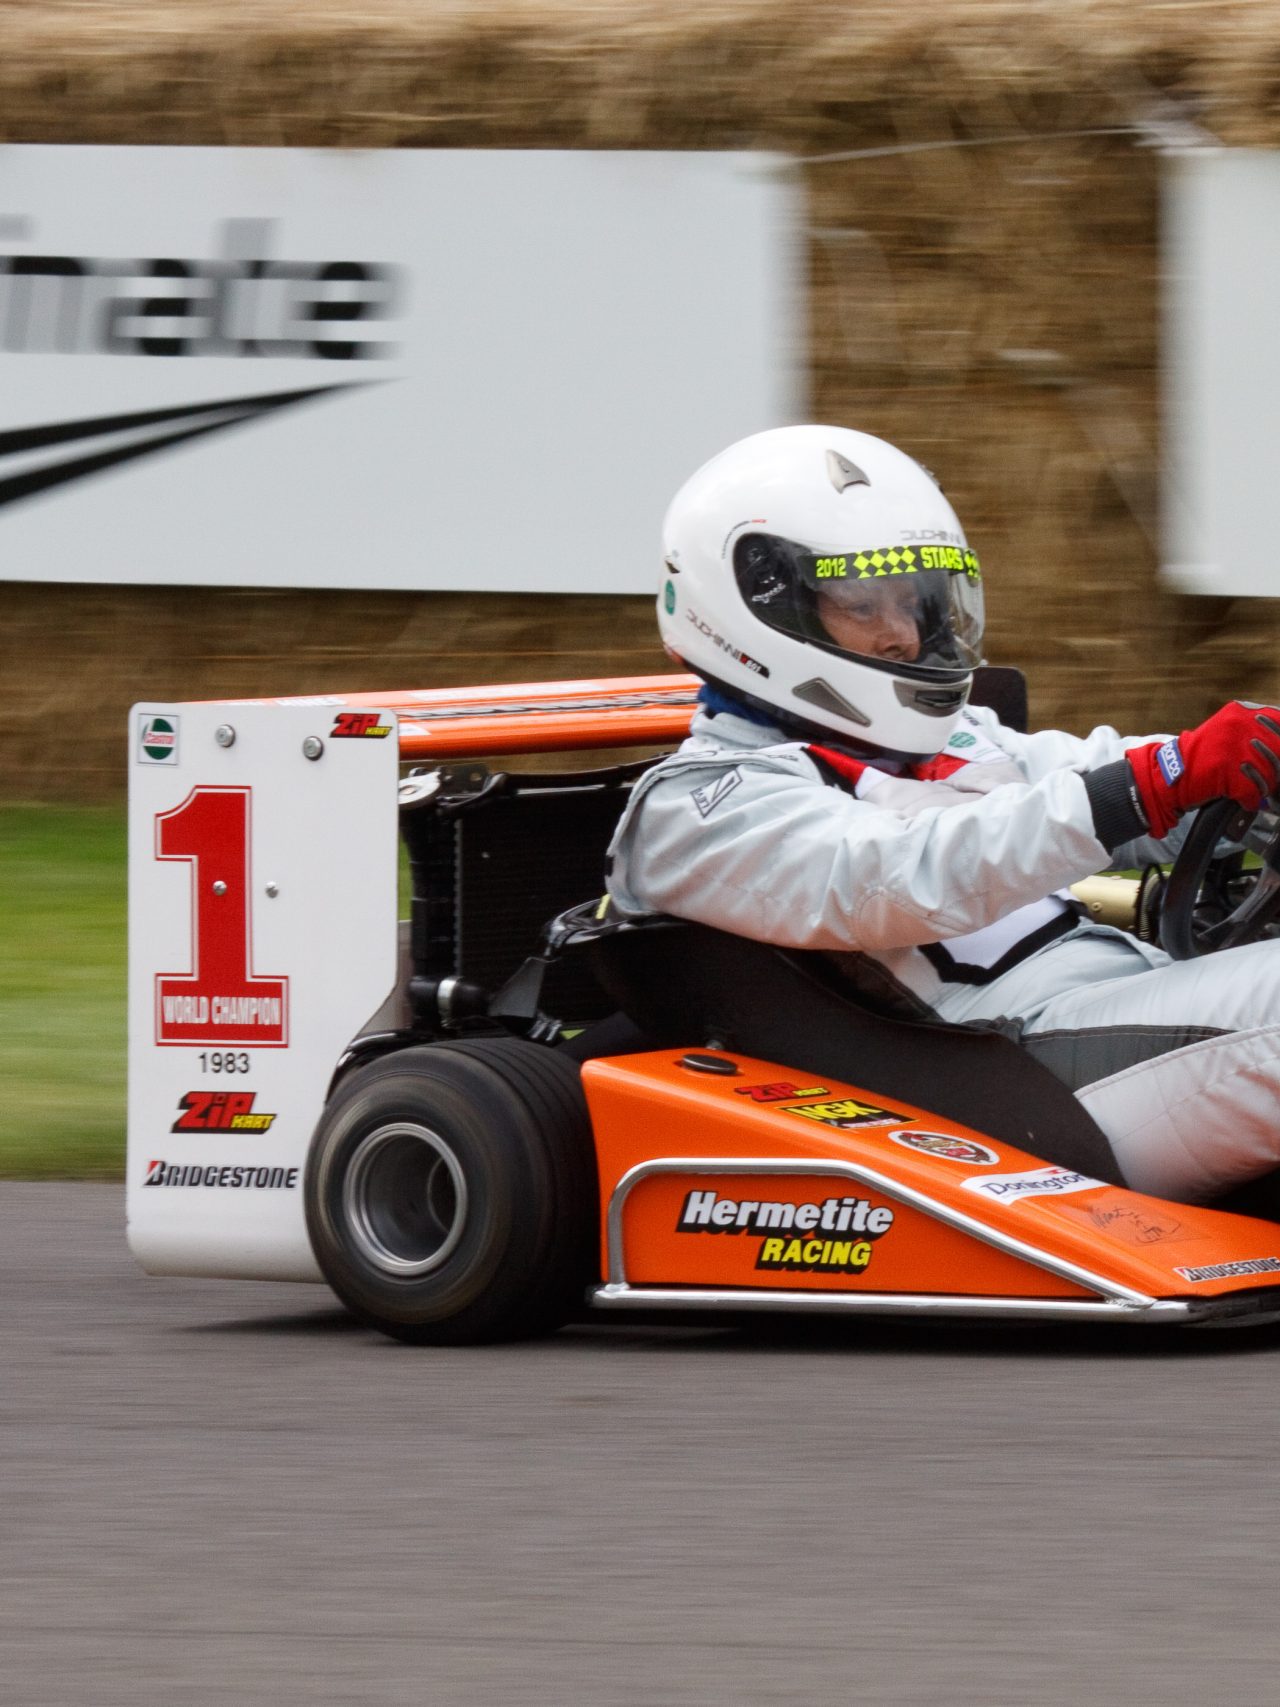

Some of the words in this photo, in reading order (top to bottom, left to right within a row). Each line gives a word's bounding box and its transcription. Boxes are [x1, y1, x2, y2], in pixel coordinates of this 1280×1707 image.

[816, 557, 847, 578] 2012
[920, 546, 964, 571] STARS
[155, 785, 289, 1048] 1
[162, 995, 209, 1024] WORLD
[212, 996, 281, 1025] CHAMPION
[198, 1052, 250, 1074] 1983
[230, 1114, 276, 1130] KART
[785, 1100, 885, 1120] NGK
[144, 1161, 299, 1189] BRIDGESTONE
[680, 1190, 895, 1236] Hermetite
[759, 1237, 874, 1269] RACING
